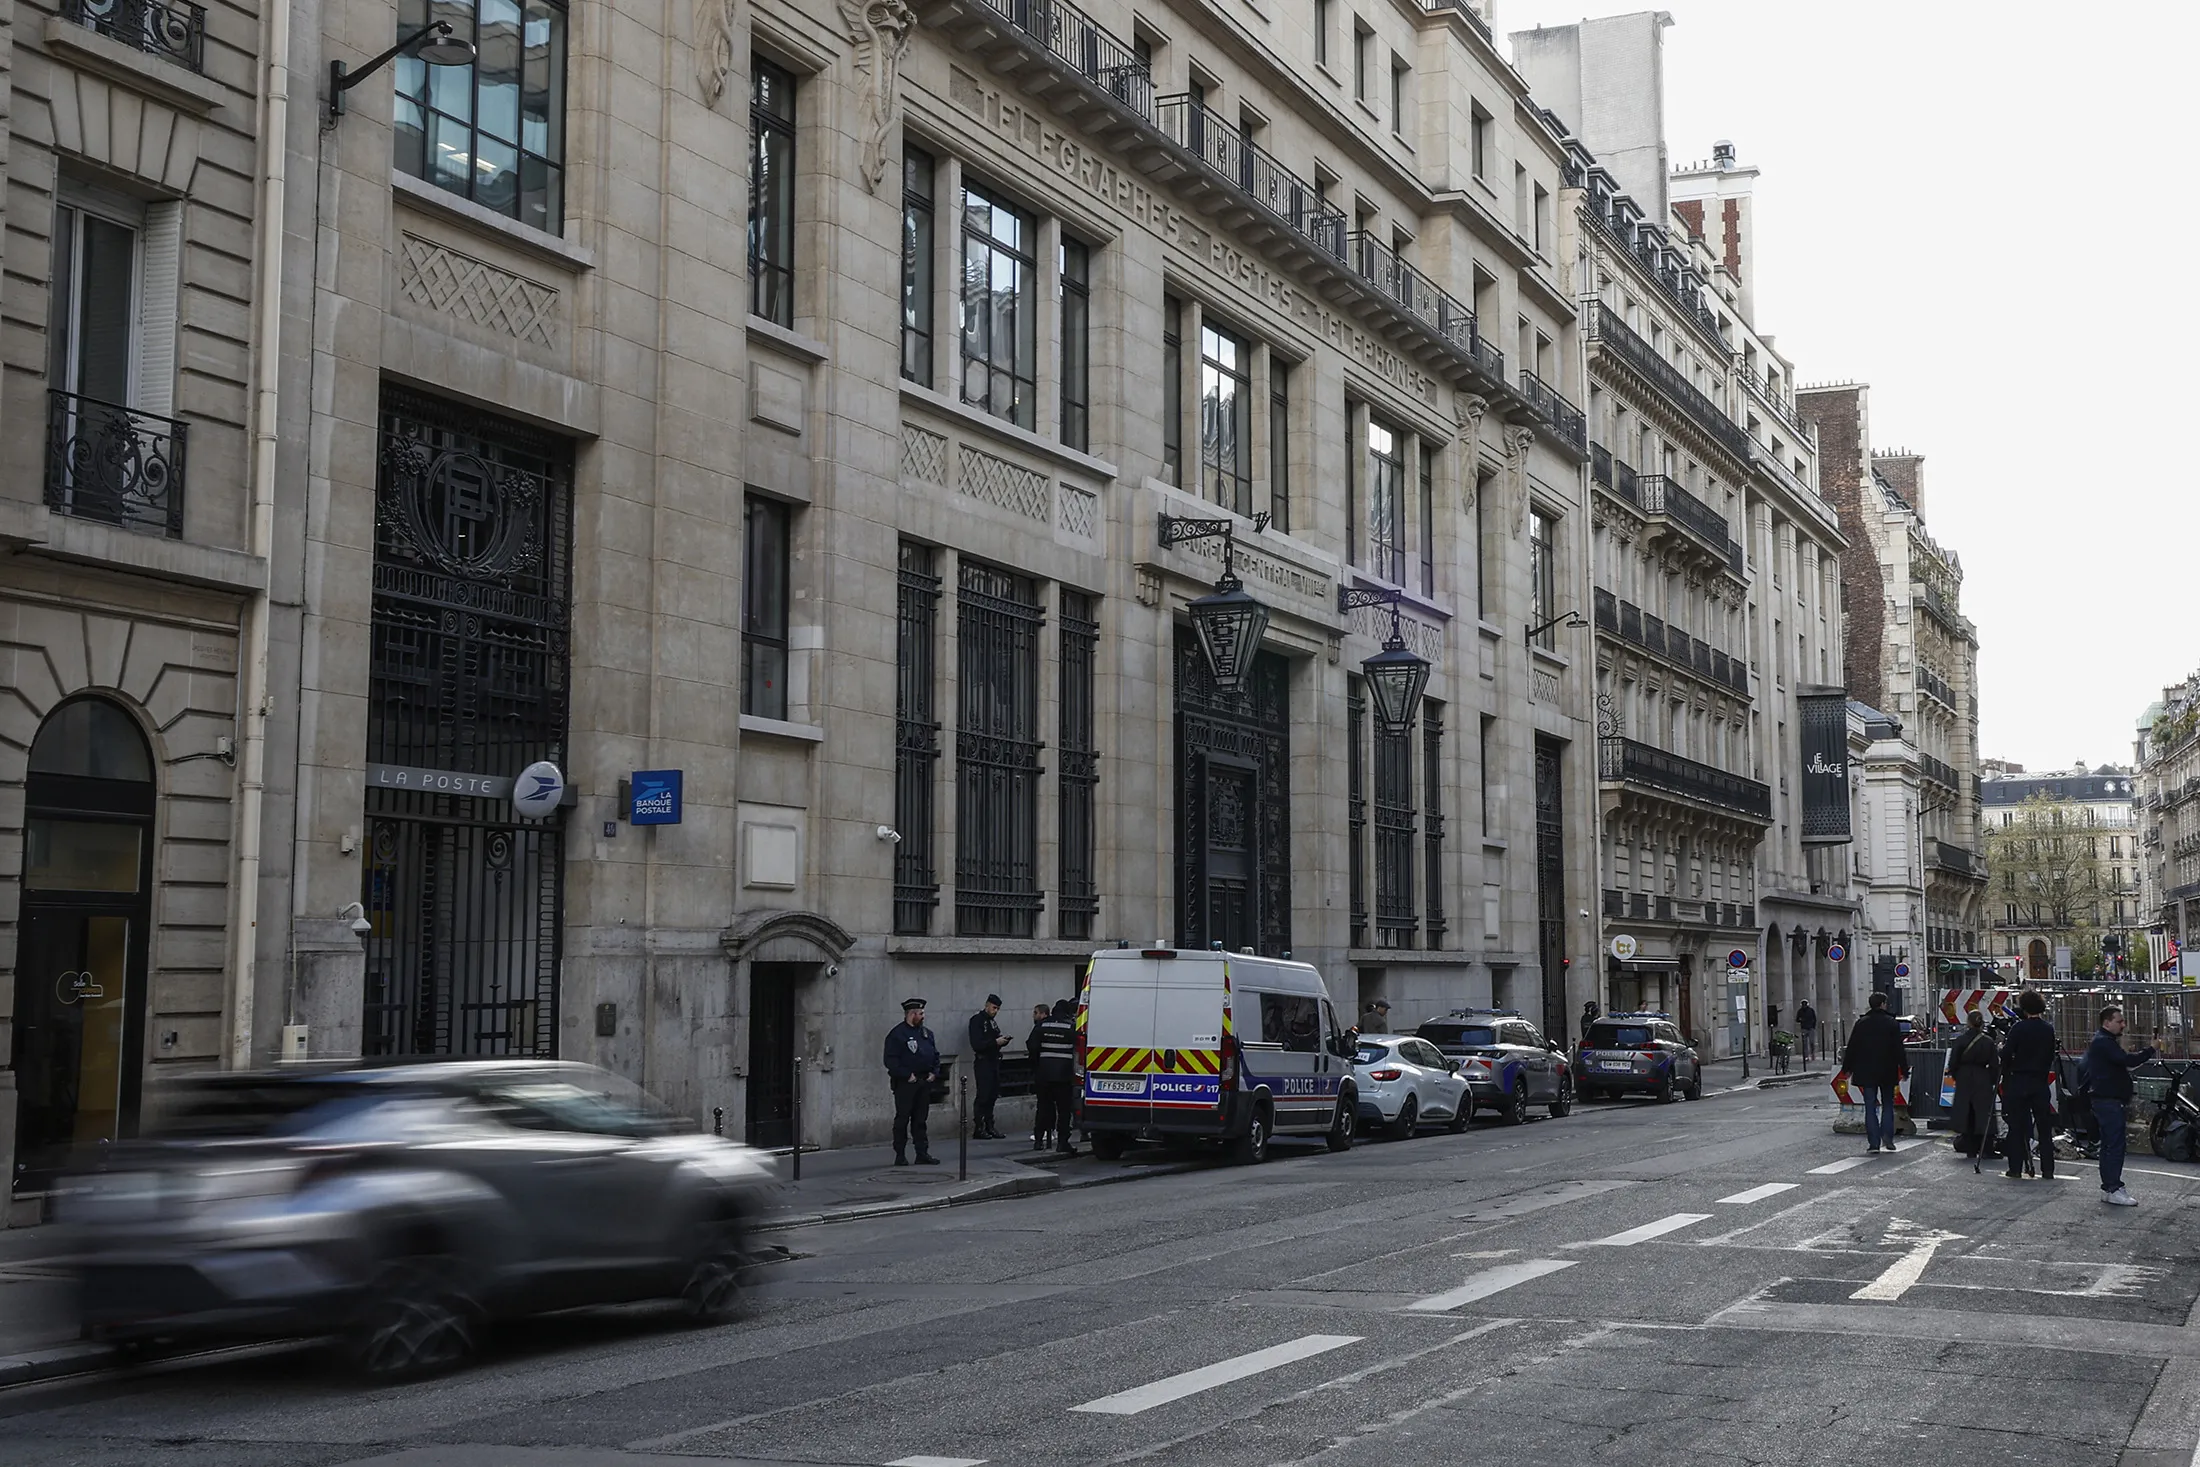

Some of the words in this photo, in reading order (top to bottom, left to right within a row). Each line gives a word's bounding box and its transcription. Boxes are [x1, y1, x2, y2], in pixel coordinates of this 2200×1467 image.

[976, 83, 1180, 243] TELEGRAPHES
[1211, 241, 1293, 314] POSTES
[1316, 307, 1427, 397] TELEPHONES
[1181, 537, 1234, 567] BUREA
[1241, 553, 1296, 590] CENTRAL
[1813, 752, 1822, 764] LE
[1807, 762, 1842, 774] VILLAGE
[380, 770, 407, 785] LA
[422, 774, 492, 793] POSTE
[636, 799, 672, 807] BANQUE
[636, 806, 672, 815] POSTALE
[1152, 1082, 1192, 1093] POLICE
[1284, 1078, 1314, 1094] POLICE
